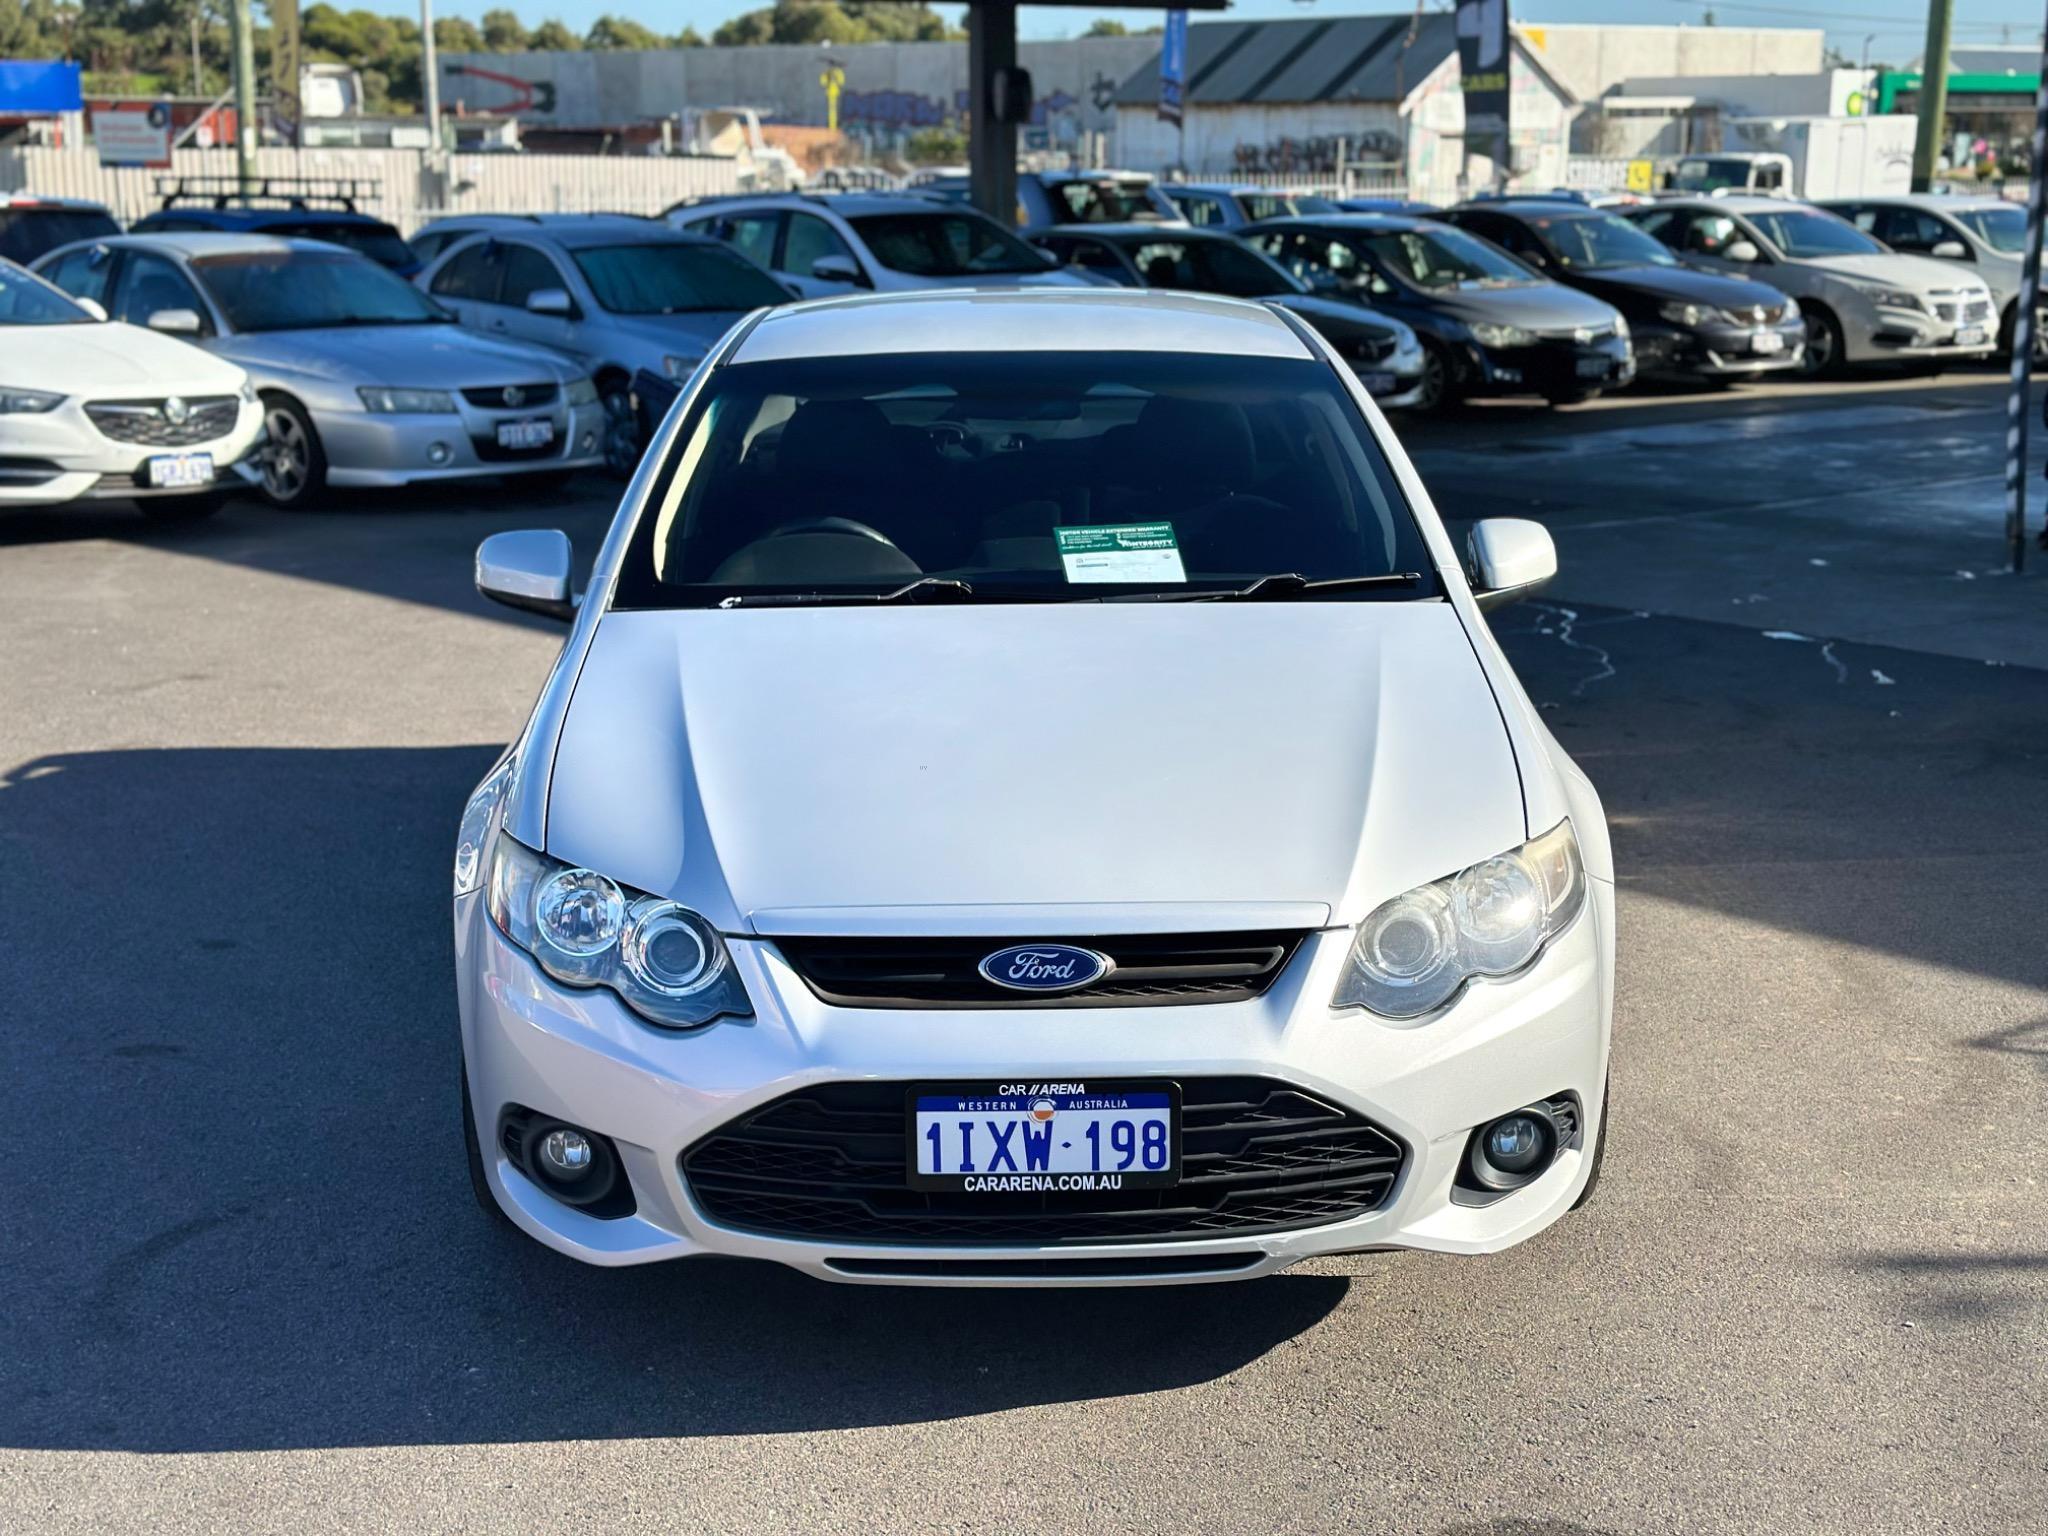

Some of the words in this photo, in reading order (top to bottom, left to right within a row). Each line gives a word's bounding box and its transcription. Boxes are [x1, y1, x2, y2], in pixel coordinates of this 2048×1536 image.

[1008, 951, 1075, 979] Ford
[999, 1084, 1026, 1096] CAR
[958, 1101, 1017, 1111] WESTERN
[1069, 1099, 1129, 1109] AUSTRALIA
[964, 1175, 1122, 1192] CARARENA.COM.AU
